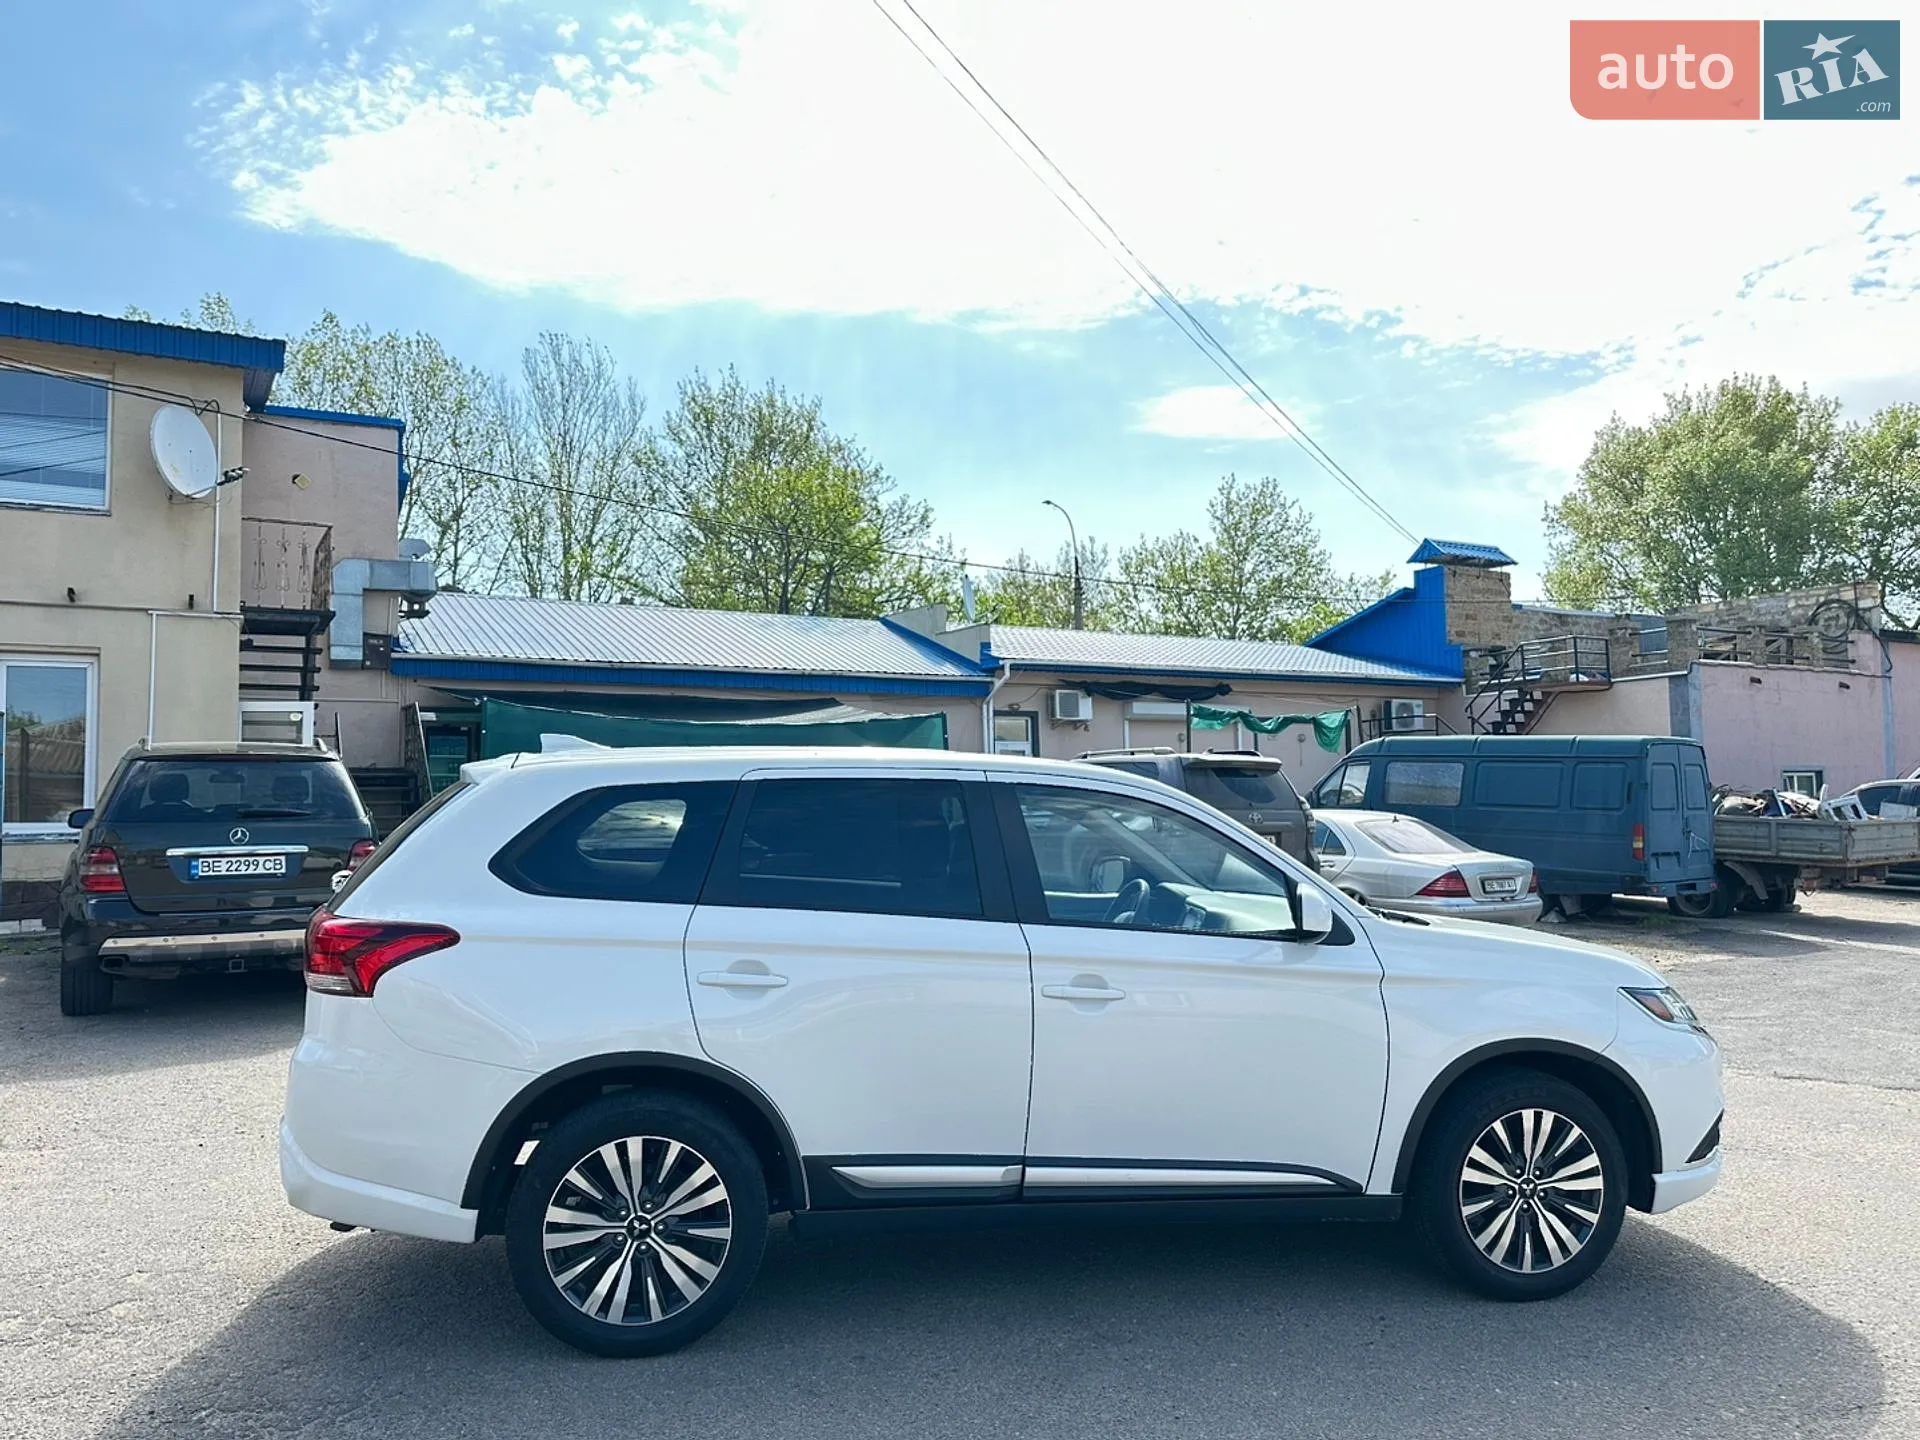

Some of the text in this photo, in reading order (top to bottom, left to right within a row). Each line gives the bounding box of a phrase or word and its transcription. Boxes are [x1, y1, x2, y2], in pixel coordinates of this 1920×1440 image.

[201, 858, 283, 873] BE 2299 CB
